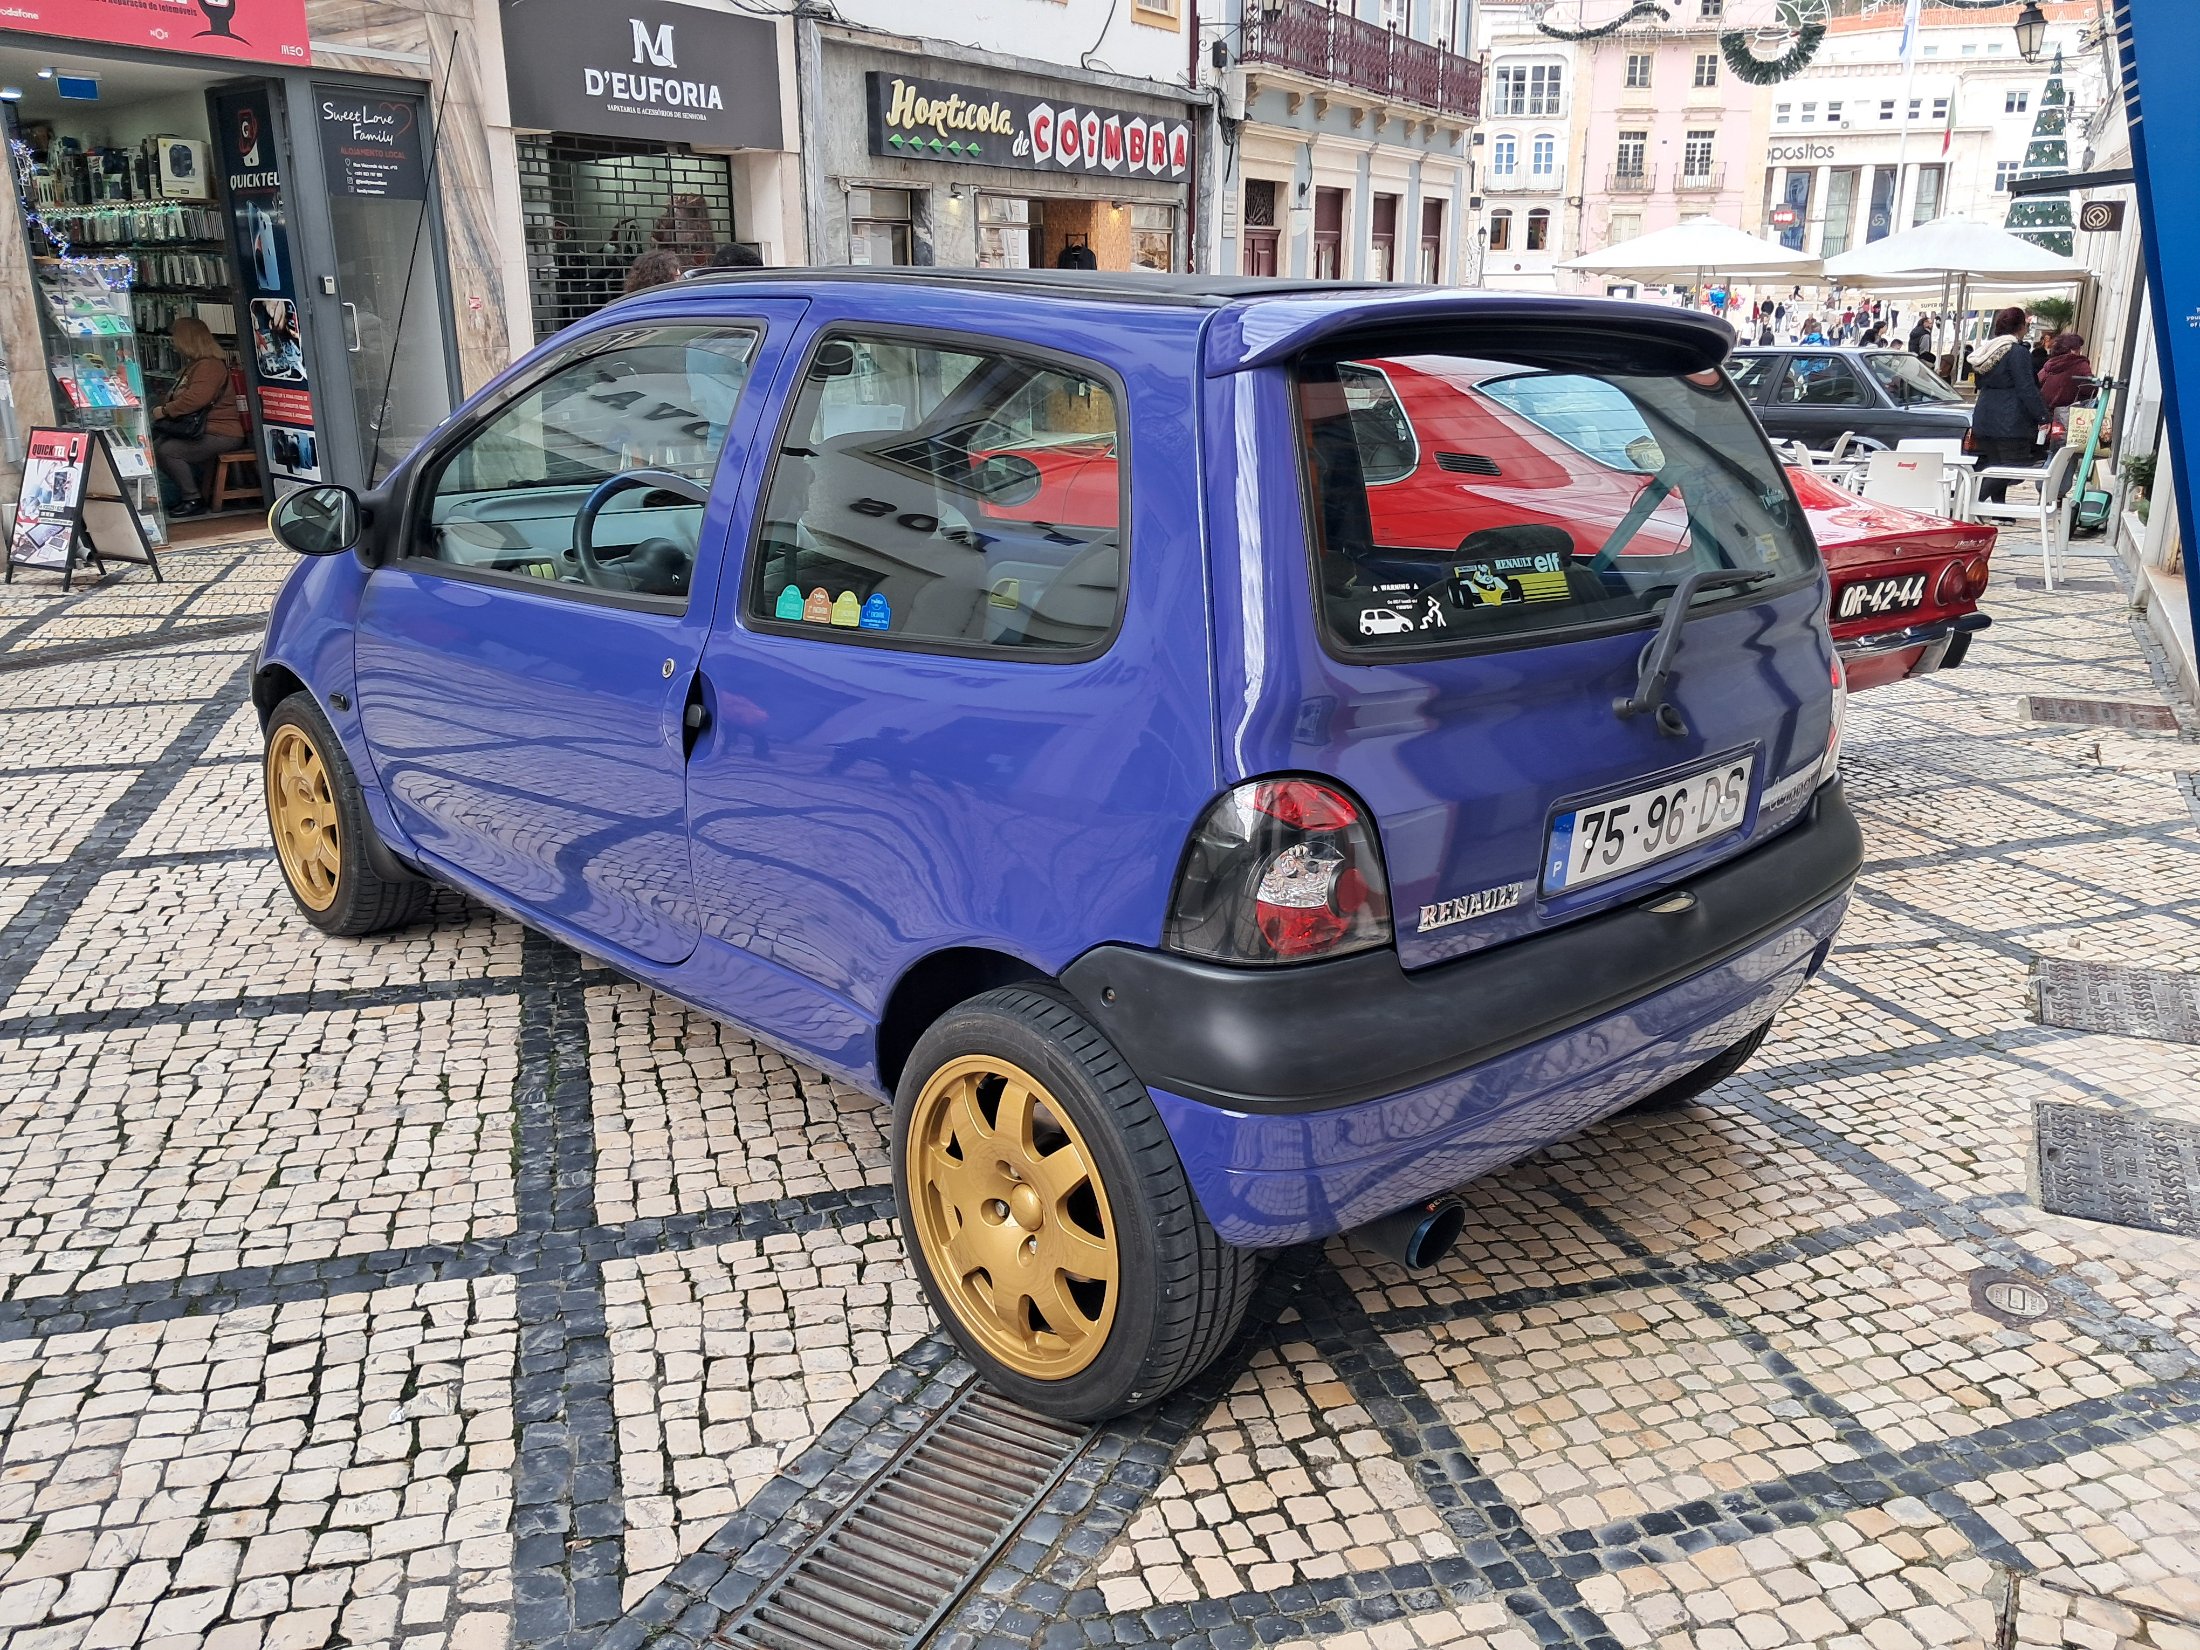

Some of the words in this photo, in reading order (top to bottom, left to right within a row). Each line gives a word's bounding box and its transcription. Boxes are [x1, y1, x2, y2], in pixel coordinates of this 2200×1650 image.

[281, 44, 304, 57] MEO
[322, 102, 361, 122] Sweet
[362, 106, 394, 124] Love
[352, 123, 394, 146] Family
[1012, 130, 1030, 158] de
[1494, 557, 1533, 570] RENAULT
[1533, 552, 1560, 573] elf
[1380, 583, 1411, 591] WARNING
[1839, 575, 1927, 618] OR-42-44
[1552, 860, 1563, 878] P
[1418, 882, 1524, 931] RENAULT
